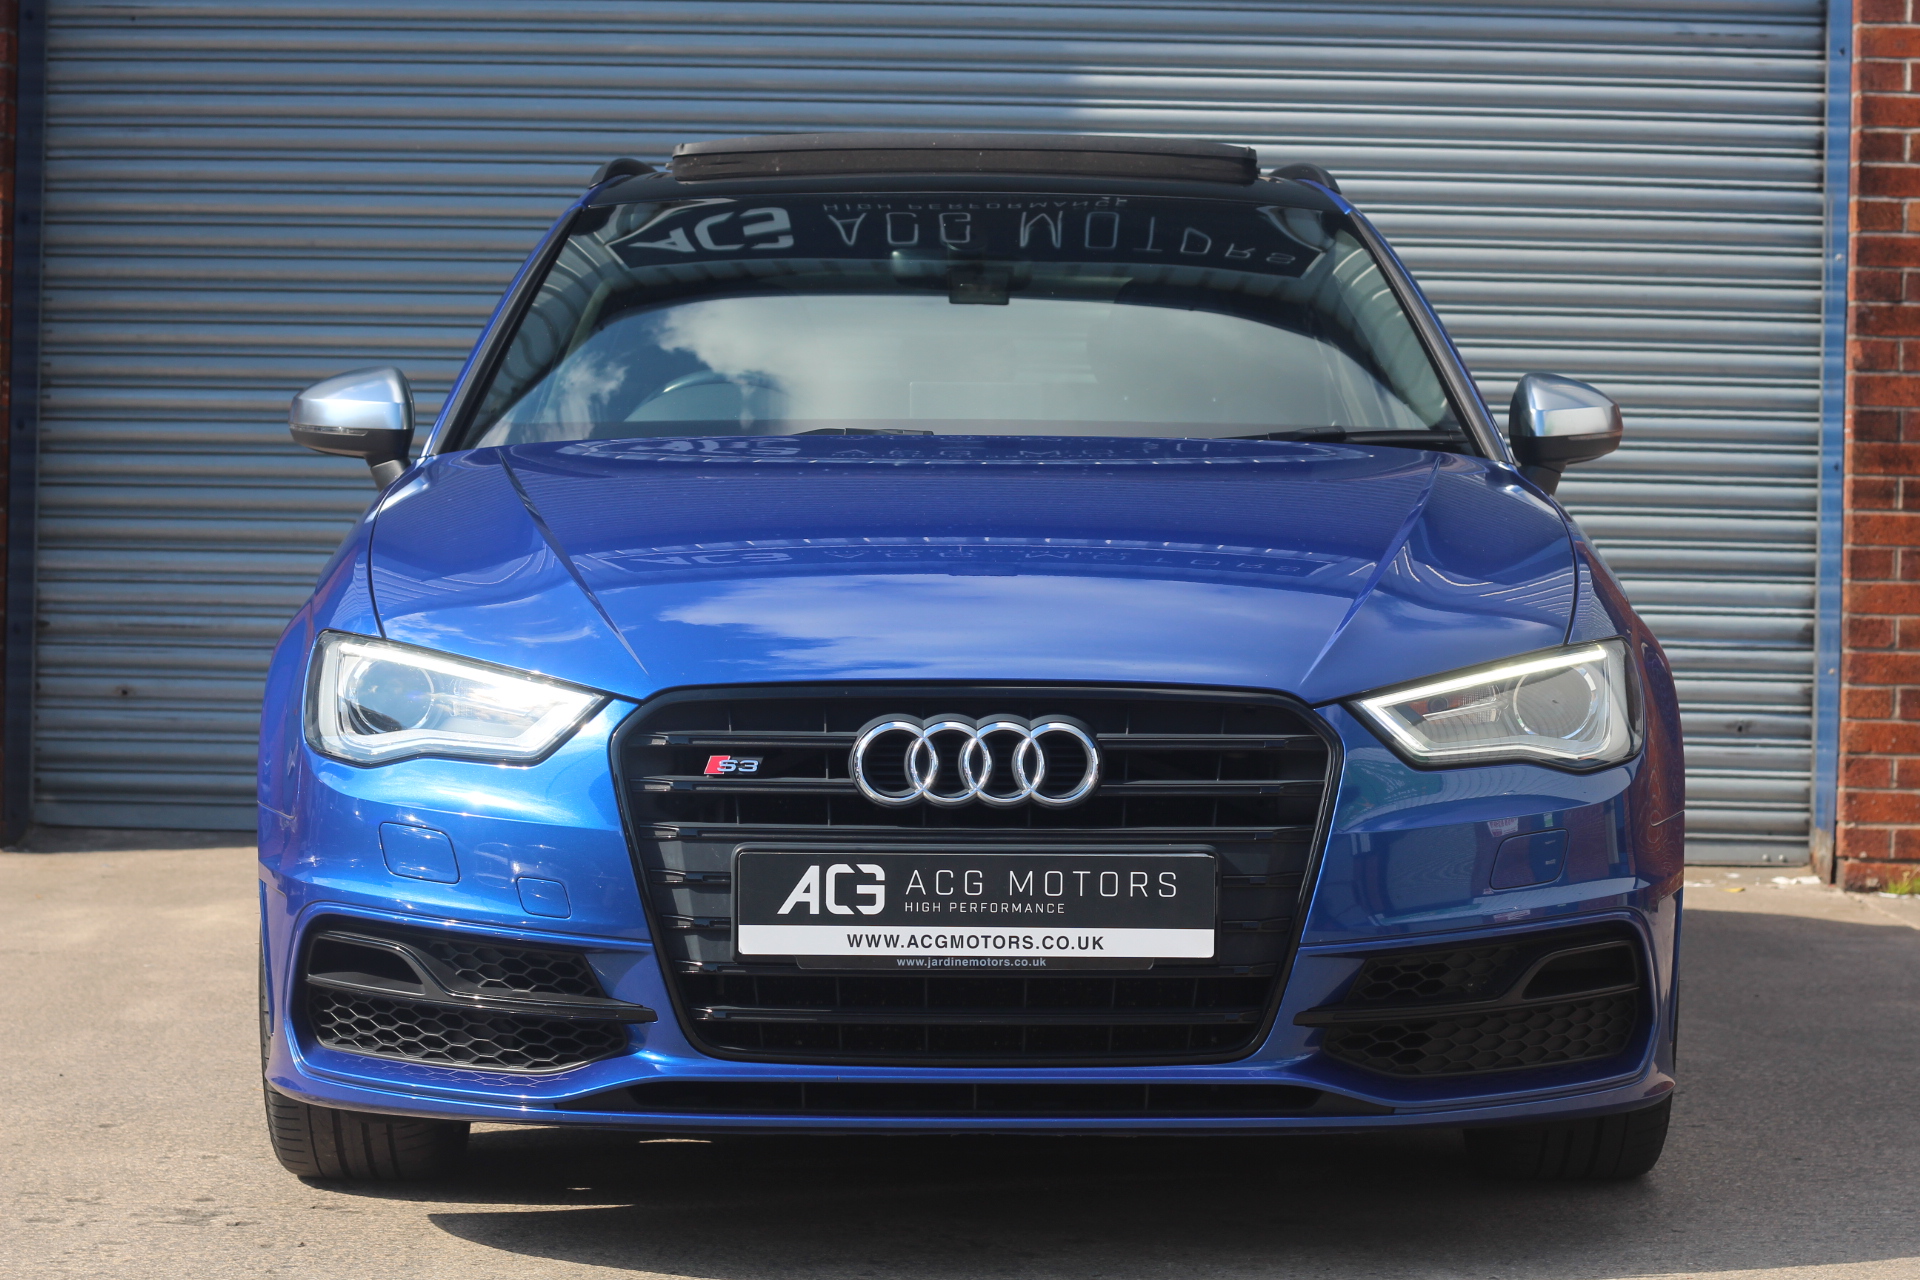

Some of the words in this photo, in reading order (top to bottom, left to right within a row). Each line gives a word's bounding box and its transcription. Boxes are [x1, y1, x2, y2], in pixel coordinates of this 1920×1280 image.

[716, 759, 760, 772] S3
[776, 863, 886, 915] ACG
[905, 869, 984, 897] ACG
[1009, 870, 1178, 898] MOTORS
[904, 901, 942, 913] HIGH
[949, 902, 1066, 914] PERFORMANCE
[846, 933, 1105, 951] WWW.ACGMOTORS.CO.UK
[896, 956, 1047, 969] www.jardinemotors.co.uk
